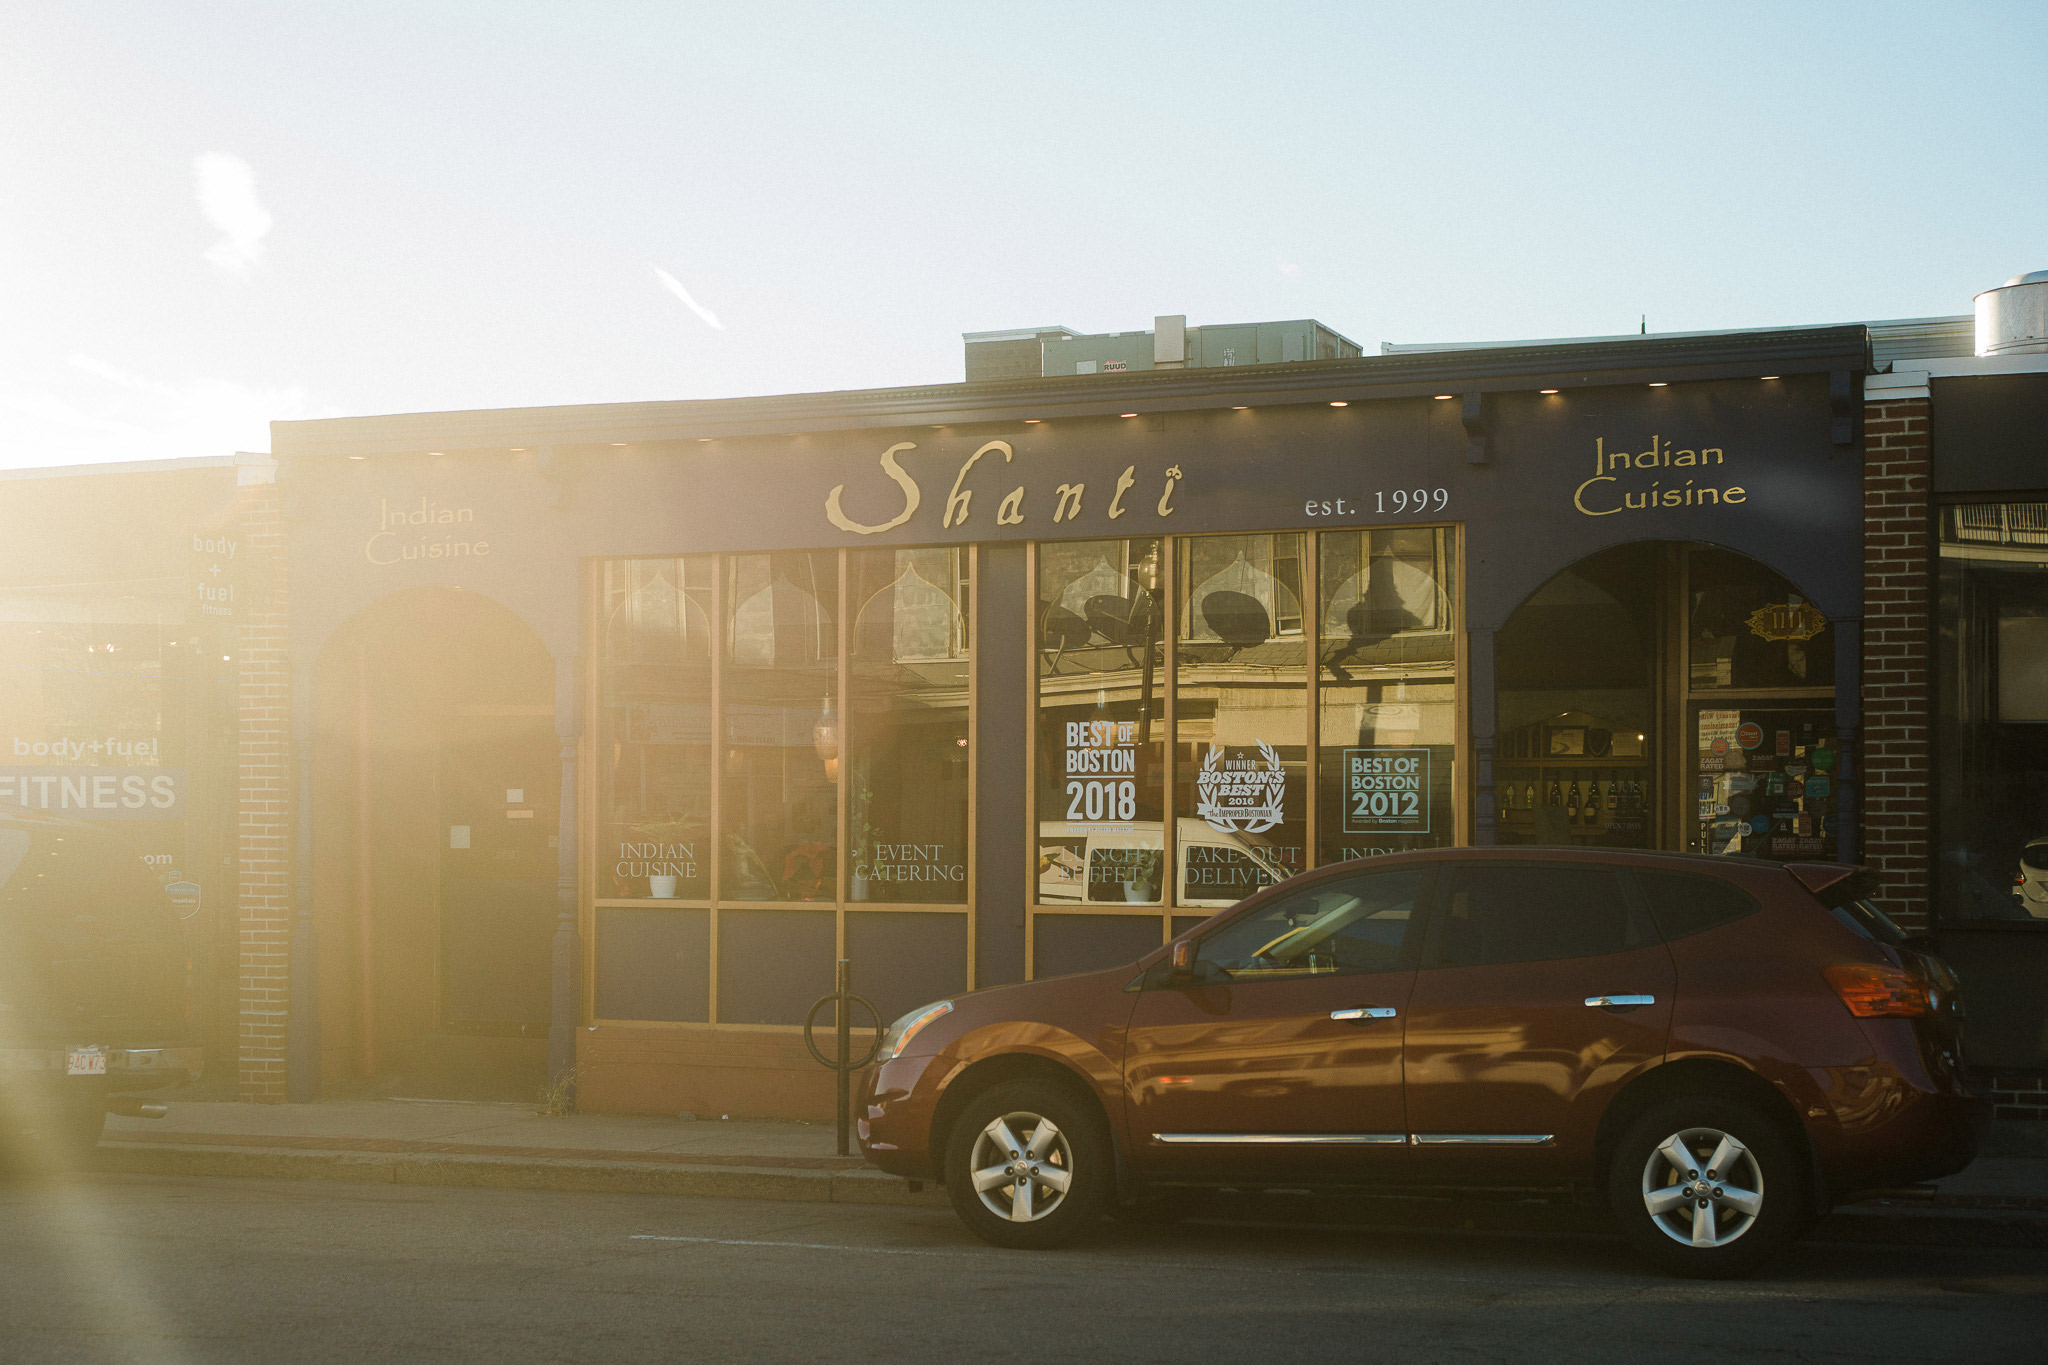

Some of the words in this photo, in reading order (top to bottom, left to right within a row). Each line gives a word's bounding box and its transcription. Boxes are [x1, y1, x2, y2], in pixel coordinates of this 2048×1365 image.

[1104, 363, 1127, 371] RUUD
[1596, 435, 1724, 476] Indian
[825, 440, 1183, 535] Shanti
[1305, 498, 1356, 516] est.
[1375, 487, 1449, 514] 1999
[1573, 480, 1747, 517] Cuisine
[379, 497, 474, 531] Indian
[193, 534, 237, 557] body
[365, 531, 491, 566] Cuisine
[197, 583, 234, 602] fuel
[201, 604, 233, 616] fitness
[1067, 721, 1115, 747] BEST
[1117, 725, 1133, 743] OF
[13, 736, 159, 761] body+fuel
[1067, 749, 1135, 773] BOSTON
[1225, 760, 1256, 770] WINNER
[1351, 757, 1393, 773] BEST
[1394, 757, 1419, 773] OF
[1197, 771, 1286, 784] BOSTON'S
[1351, 776, 1419, 789] BOSTON
[0, 775, 176, 809] FITNESS
[1218, 784, 1265, 796] BEST
[1066, 780, 1136, 821] 2018
[1228, 797, 1254, 805] 2016
[1351, 792, 1419, 816] 2012
[620, 842, 695, 860] INDIAN
[876, 844, 944, 862] EVENT
[1061, 846, 1141, 864] LUNCH
[1186, 846, 1301, 864] TAKE-OUT
[1341, 848, 1418, 862] IND
[616, 861, 697, 879] CUISINE
[855, 864, 965, 882] CATERING
[1060, 866, 1143, 883] BUFFET
[1185, 867, 1298, 885] DELIVERY
